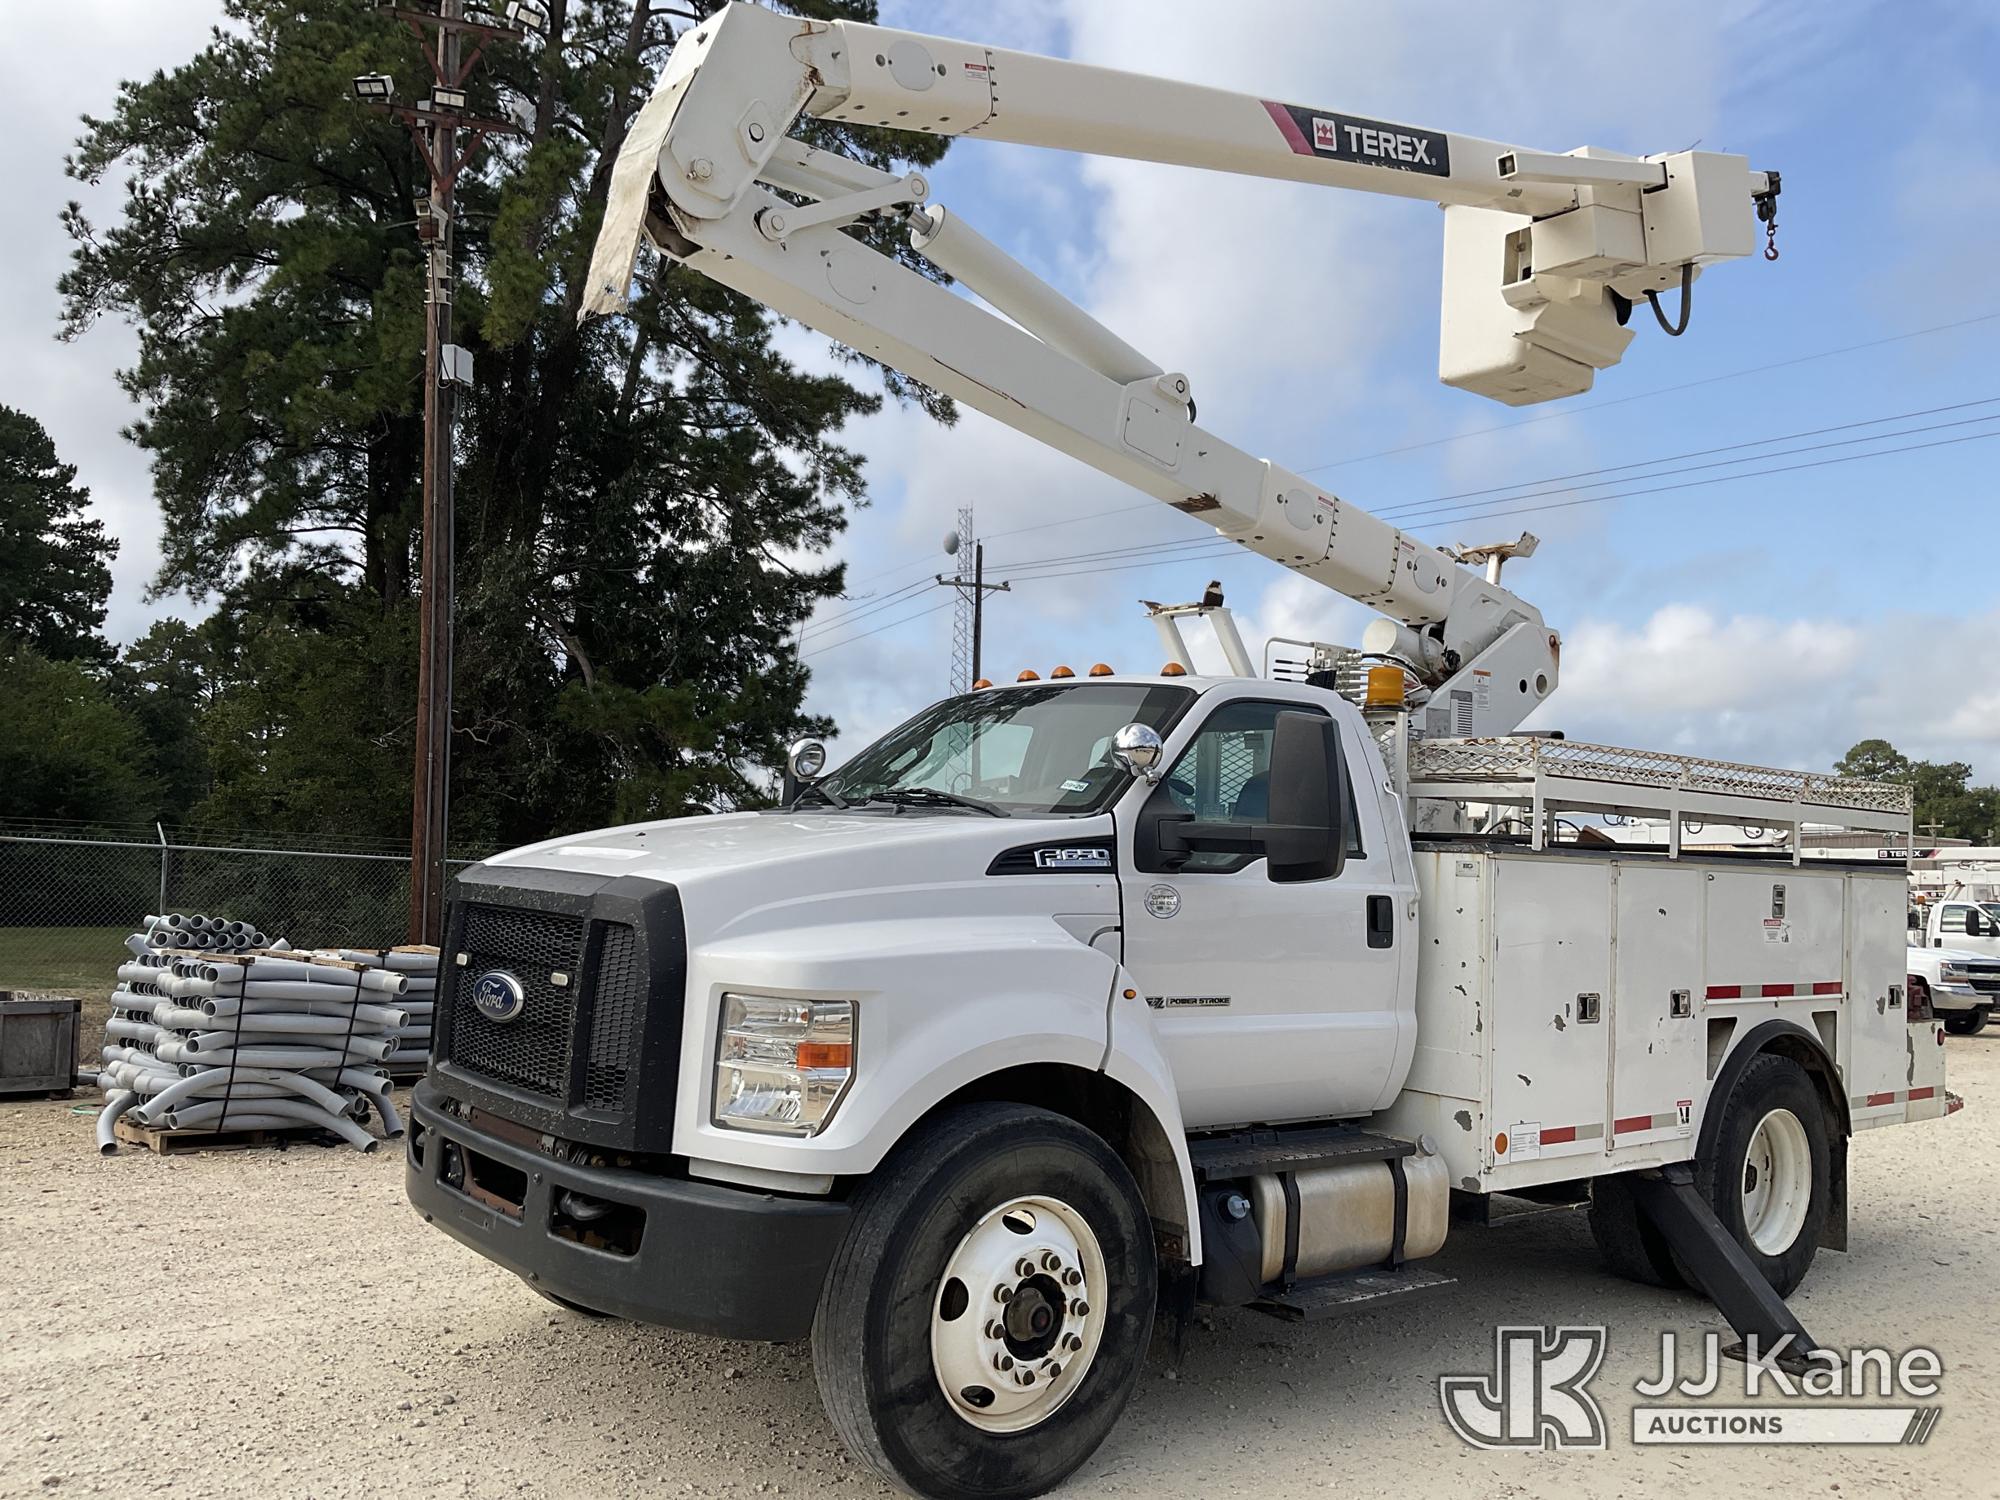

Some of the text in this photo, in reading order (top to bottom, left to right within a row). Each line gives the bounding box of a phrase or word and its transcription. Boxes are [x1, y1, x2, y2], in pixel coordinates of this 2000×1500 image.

[1343, 124, 1431, 165] TEREX
[1889, 850, 1921, 858] TERX
[479, 980, 506, 1009] Ford
[1169, 997, 1198, 1005] POWER
[1198, 996, 1230, 1004] STROKE
